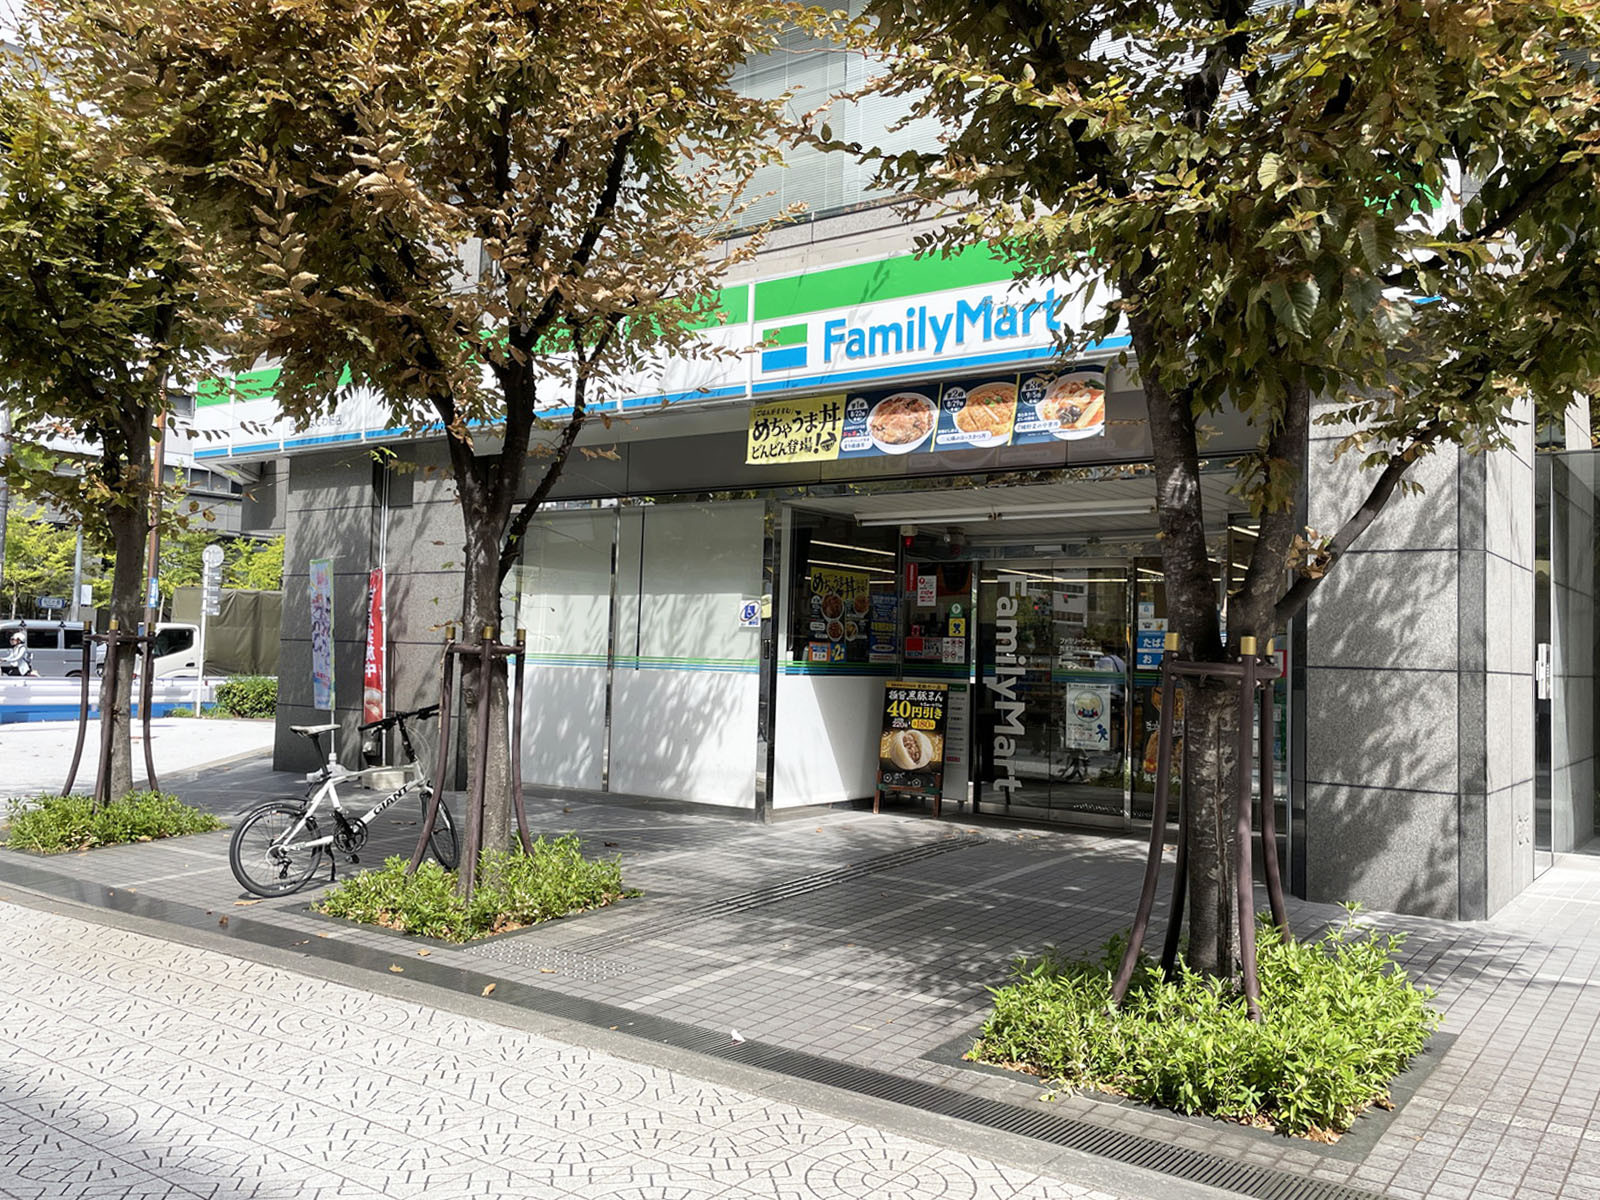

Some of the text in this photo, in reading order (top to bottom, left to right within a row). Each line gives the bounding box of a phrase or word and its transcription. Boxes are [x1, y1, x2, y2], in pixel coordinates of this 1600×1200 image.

[824, 288, 1062, 363] FamilyMart
[752, 402, 841, 442] めちゃうま丼
[1142, 638, 1166, 648] たば
[983, 575, 1028, 793] FamilyMart
[886, 700, 943, 719] 40円引き
[373, 785, 407, 814] GIANT
